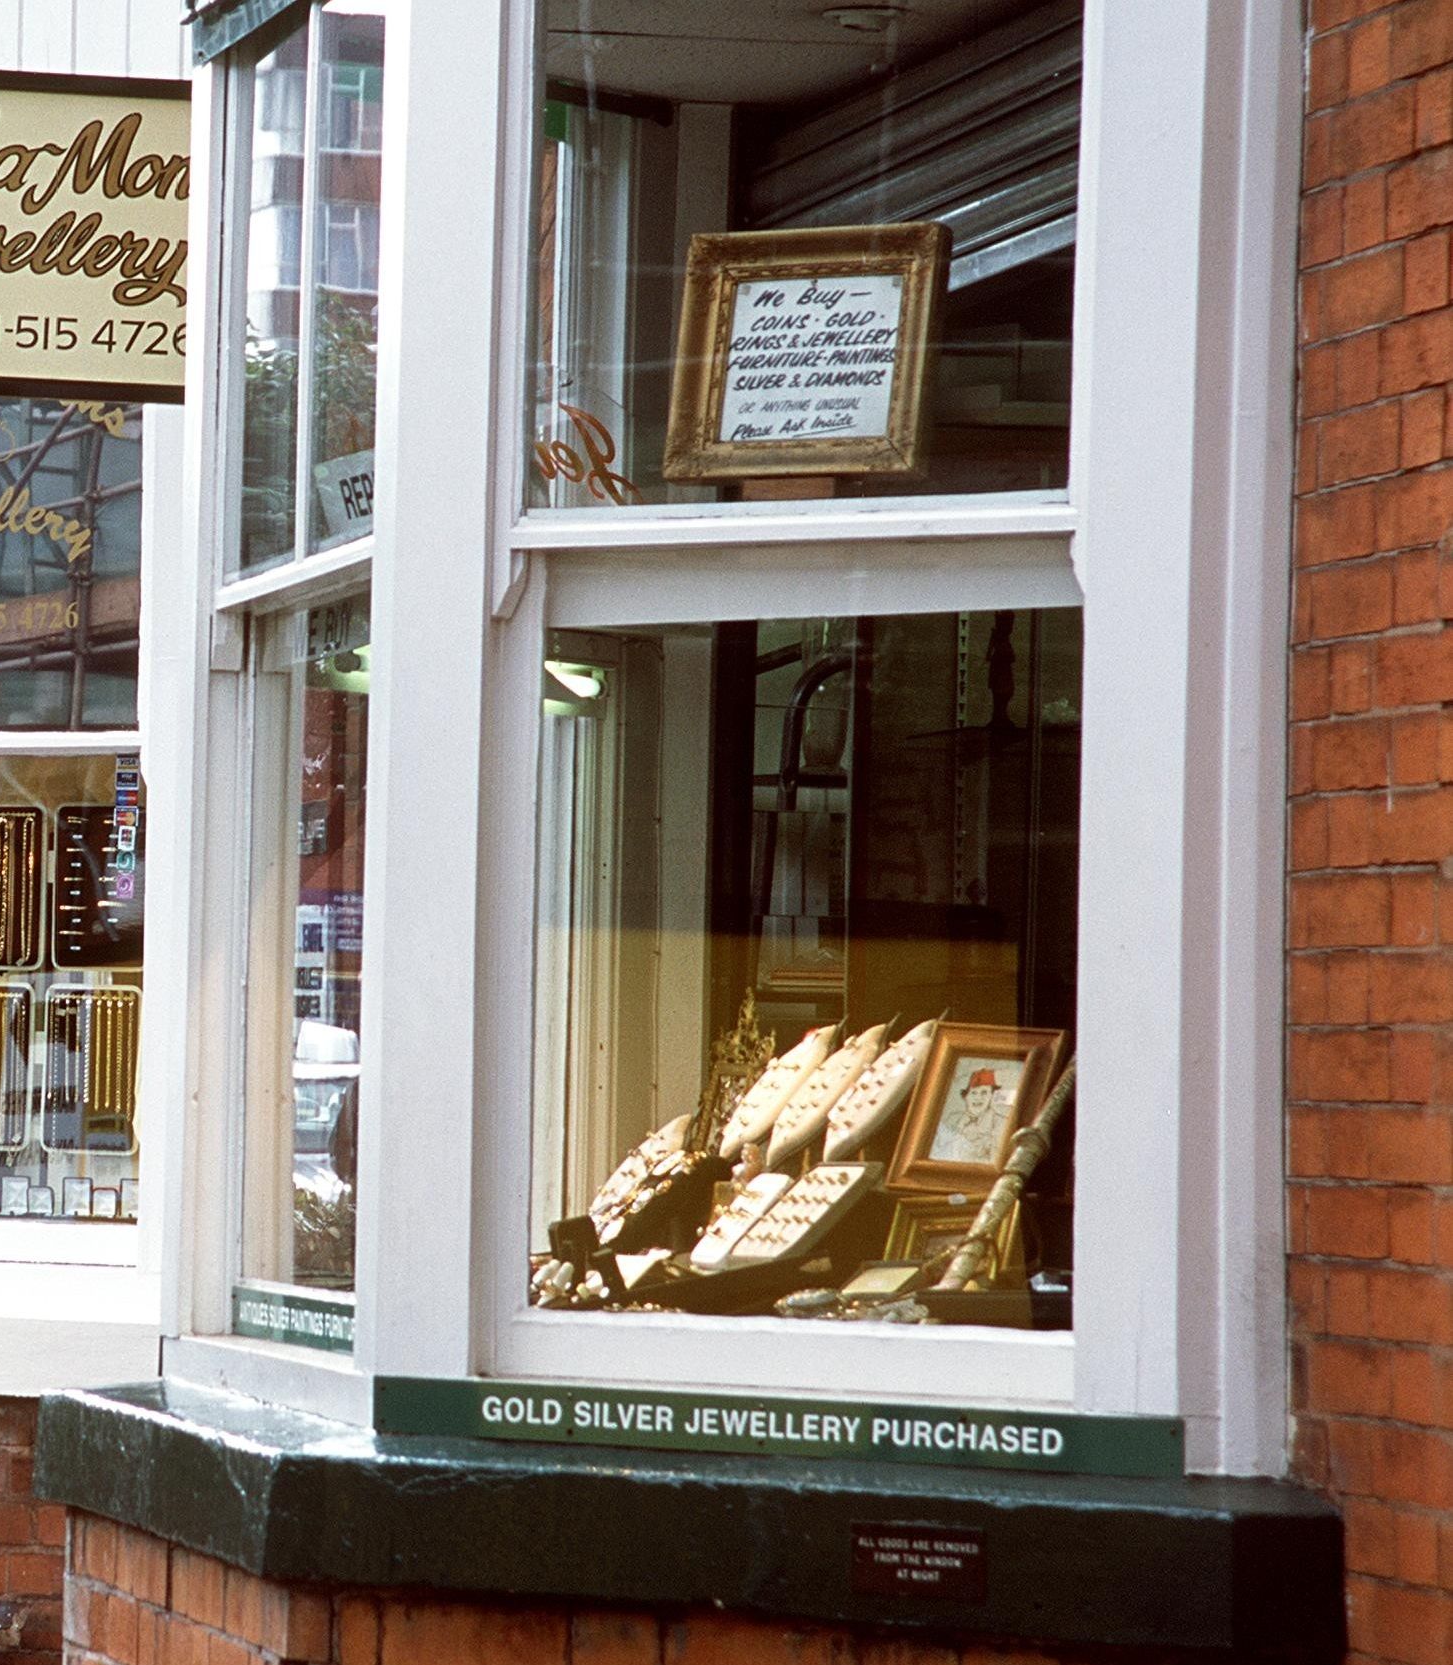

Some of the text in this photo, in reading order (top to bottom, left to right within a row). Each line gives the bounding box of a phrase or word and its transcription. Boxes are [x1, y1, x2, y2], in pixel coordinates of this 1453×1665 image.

[753, 286, 846, 310] We Buy
[750, 310, 876, 333] COINS GOLD
[91, 319, 186, 356] 4726
[730, 327, 898, 351] RINGS & JEWELLERY
[733, 369, 886, 391] SILVER & DIAMONDS
[761, 399, 811, 413] ANYTHING
[815, 397, 861, 412] UNUSUAL
[339, 470, 375, 519] REP
[18, 601, 79, 630] 4726
[482, 1396, 1063, 1456] GOLD SILVER JEWELLERY PURCHASED
[874, 1552, 900, 1563] FROM
[878, 1538, 909, 1549] GOODS
[912, 1540, 929, 1551] ARE
[933, 1541, 979, 1554] REMOVED
